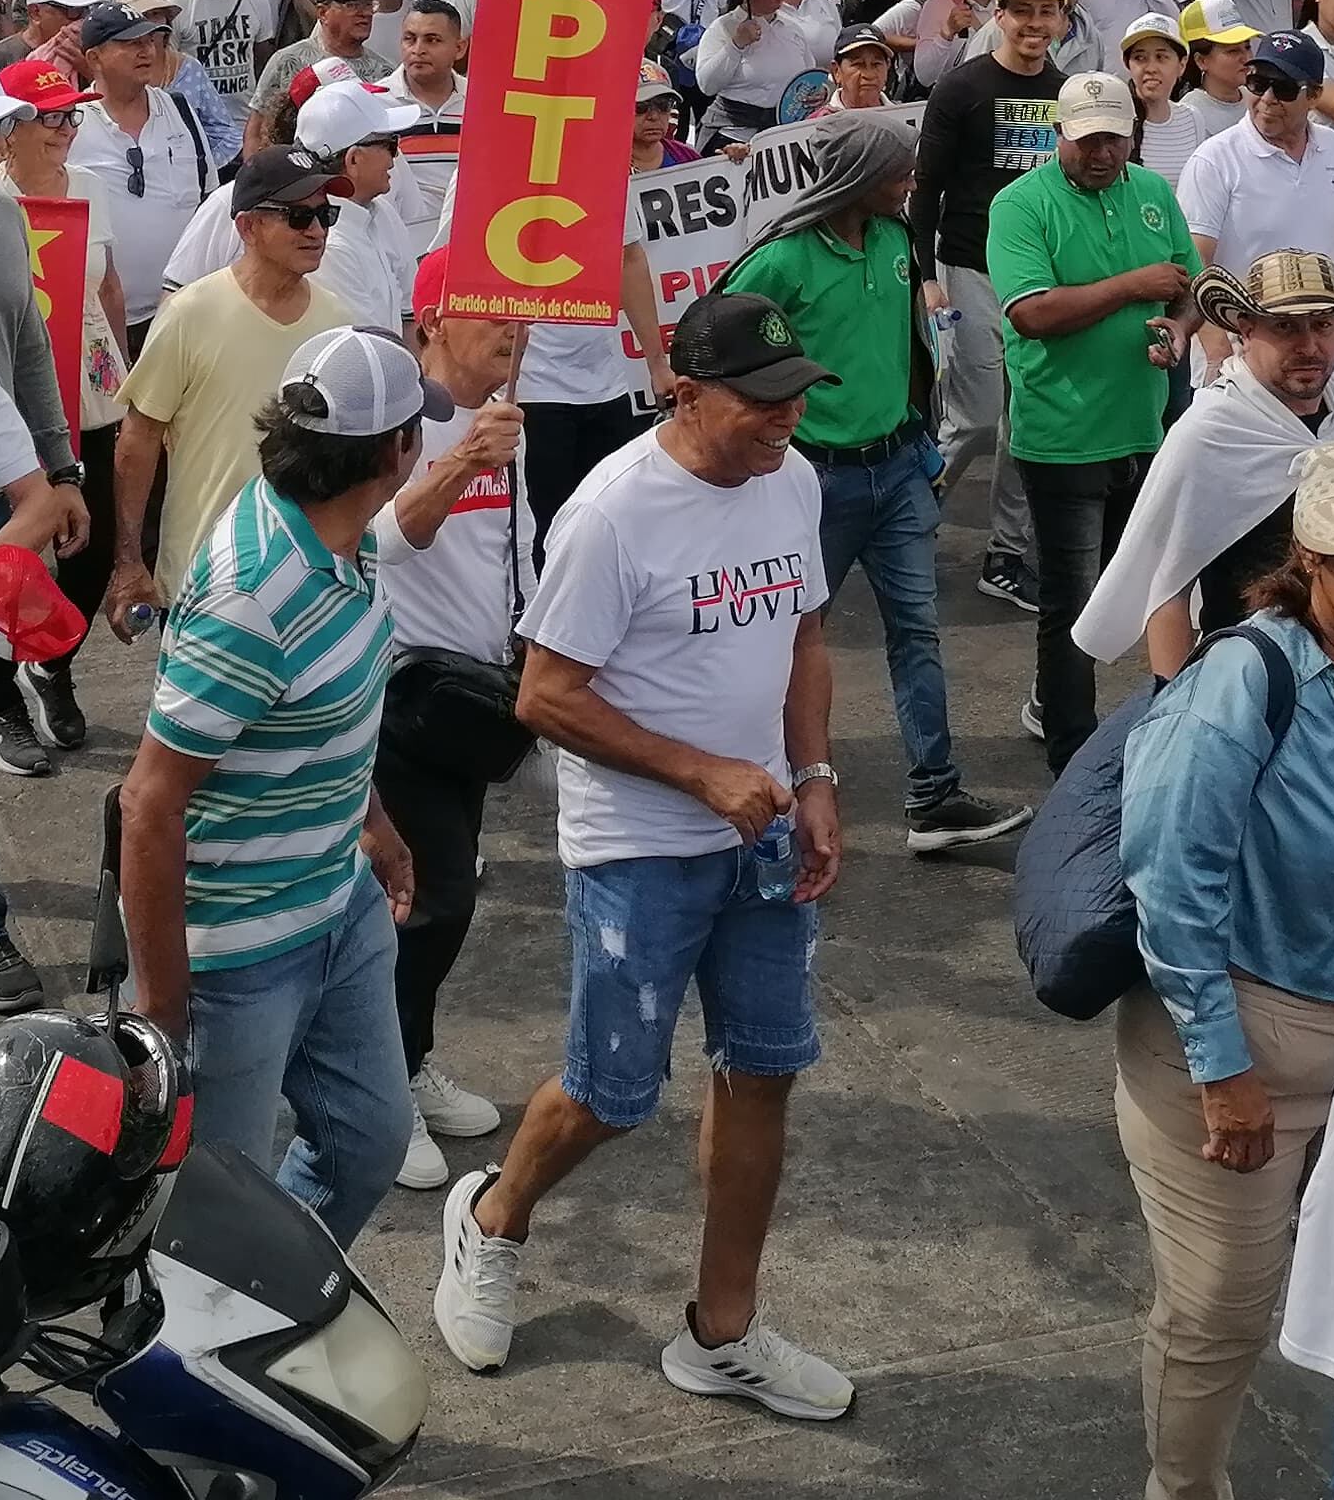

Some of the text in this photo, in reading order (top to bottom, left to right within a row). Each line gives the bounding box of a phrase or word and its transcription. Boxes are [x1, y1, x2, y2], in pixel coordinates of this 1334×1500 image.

[195, 15, 251, 45] TAKE
[197, 41, 249, 68] RISK
[448, 293, 612, 319] Partido del Trabajo de Colombia
[319, 1271, 341, 1298] Hero
